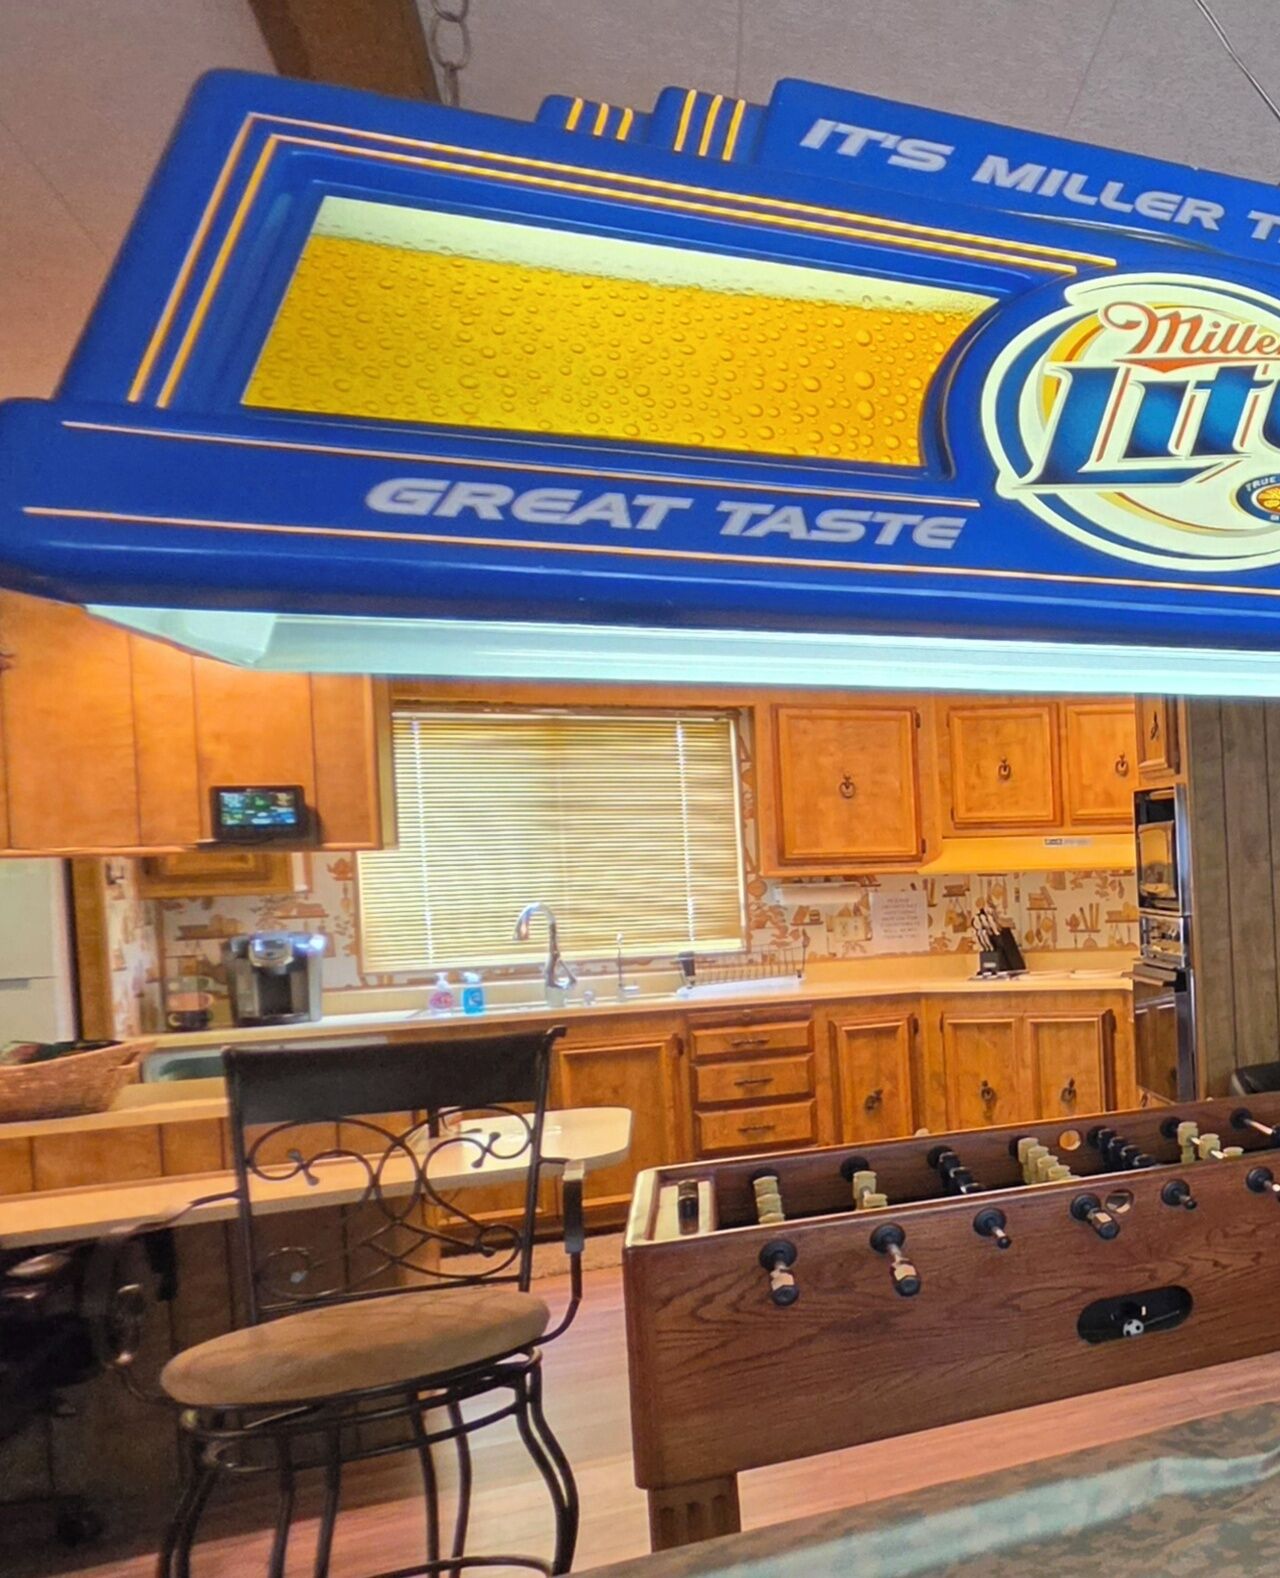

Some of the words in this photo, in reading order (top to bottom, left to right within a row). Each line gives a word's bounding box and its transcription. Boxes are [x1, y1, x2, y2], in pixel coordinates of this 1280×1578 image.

[799, 118, 955, 173] IT'S
[971, 154, 1225, 232] MILLER
[365, 476, 694, 531] GREAT
[716, 499, 967, 549] TASTE
[1245, 475, 1277, 492] TRUE
